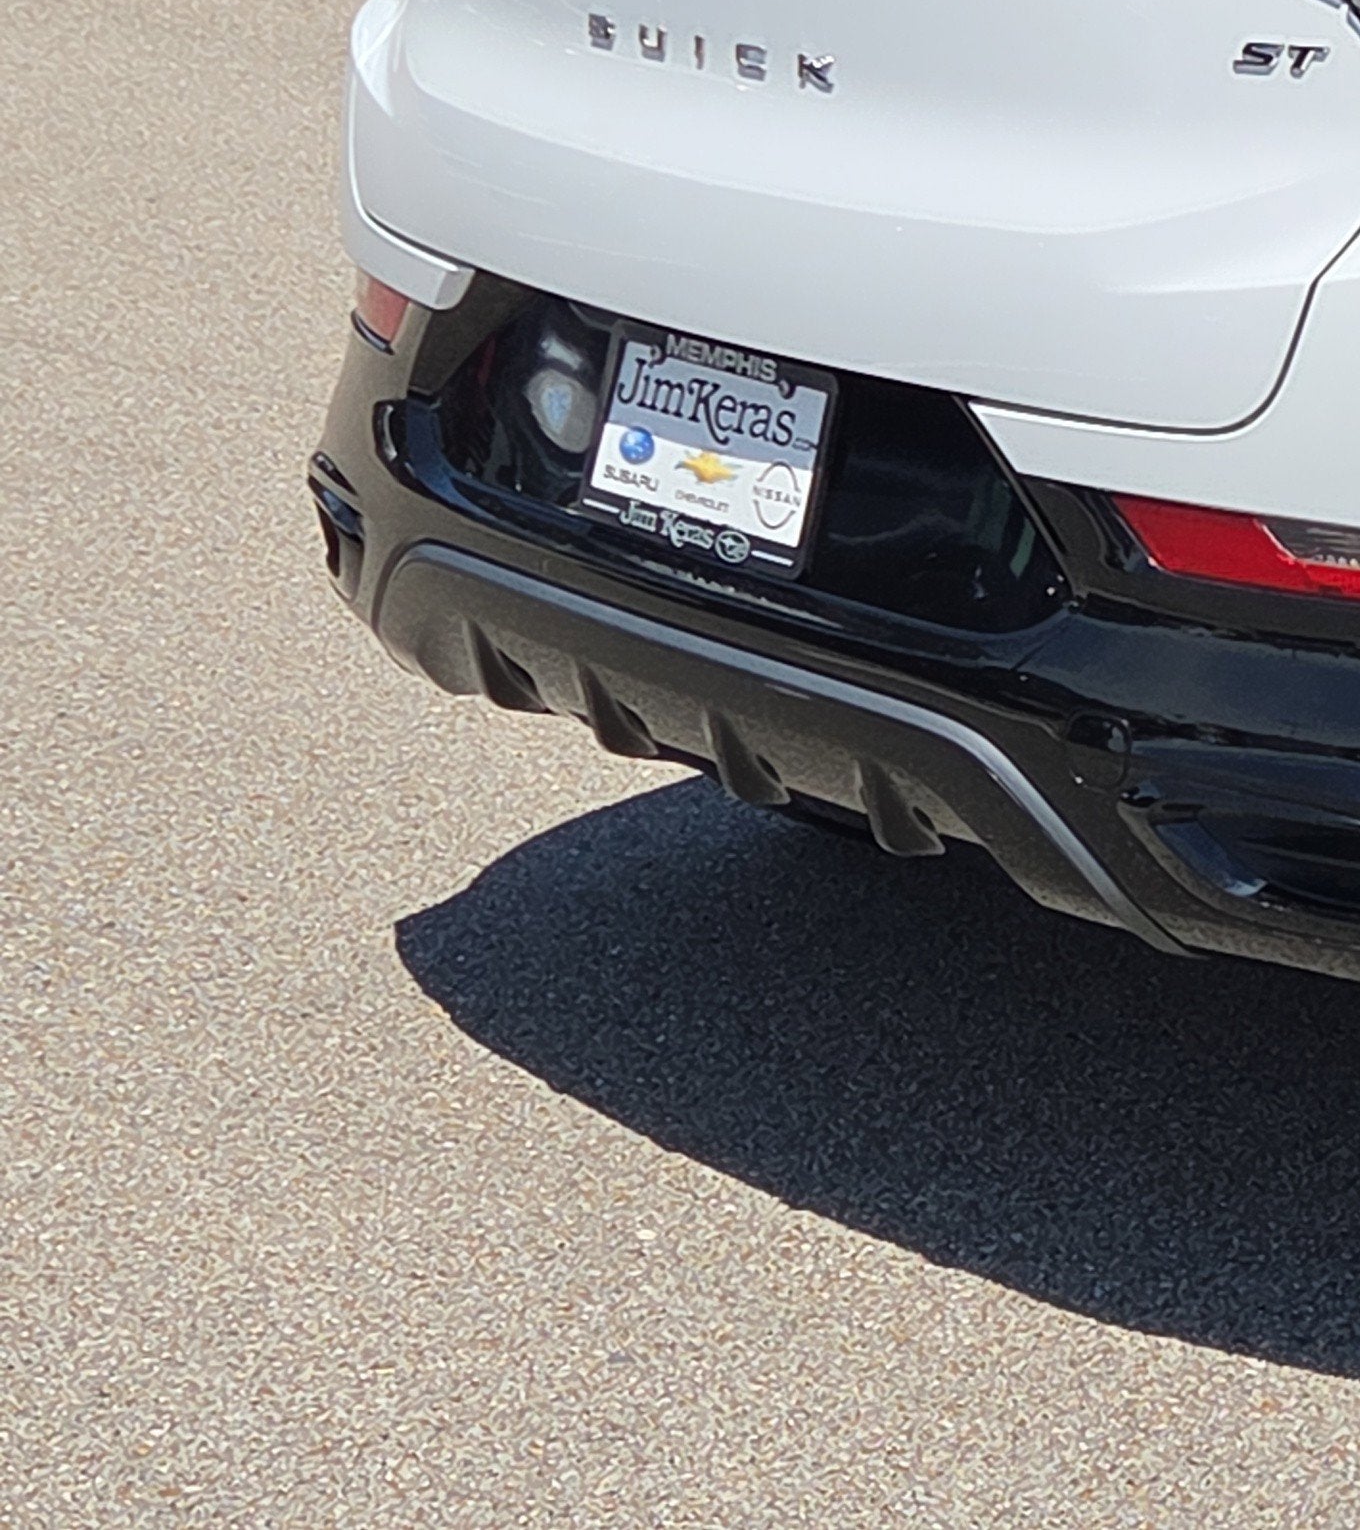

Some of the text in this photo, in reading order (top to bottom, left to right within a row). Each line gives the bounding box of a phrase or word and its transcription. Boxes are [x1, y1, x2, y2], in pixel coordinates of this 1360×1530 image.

[588, 13, 834, 93] BUICK
[1233, 42, 1331, 79] ST
[666, 333, 778, 382] MEMPHIS
[603, 464, 659, 492] SUBARU
[753, 485, 800, 507] NISSAN
[619, 500, 658, 532] Jim
